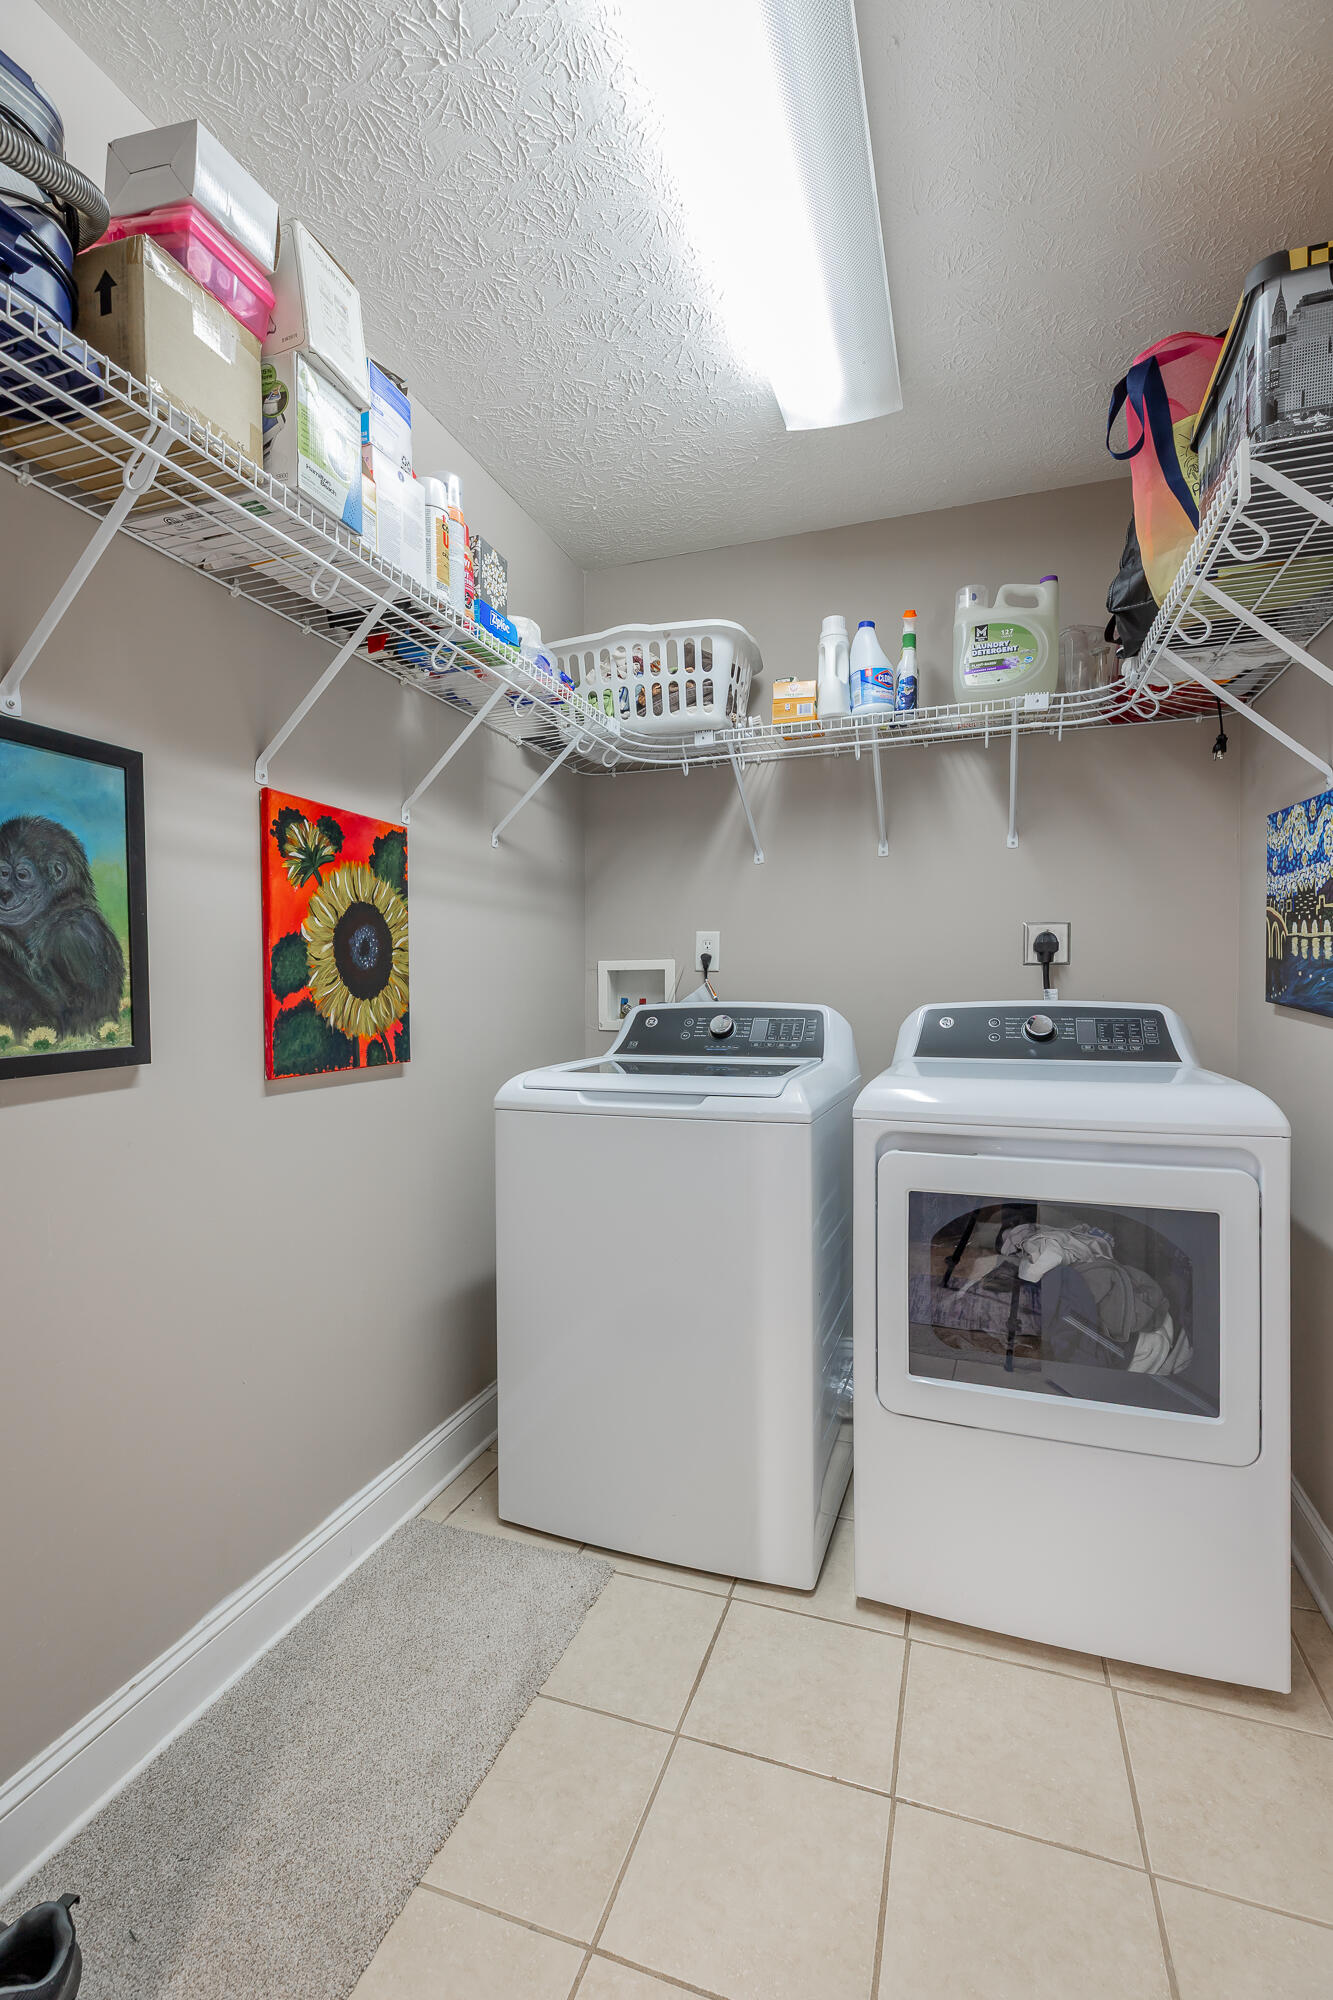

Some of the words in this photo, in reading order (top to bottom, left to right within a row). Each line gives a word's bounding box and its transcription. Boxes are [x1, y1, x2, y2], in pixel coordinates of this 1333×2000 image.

[305, 463, 332, 486] Hamilton
[320, 479, 337, 497] Beach
[491, 612, 511, 634] Ziploc
[971, 640, 1010, 650] LAUNDRY
[971, 645, 1019, 657] DETERGENT
